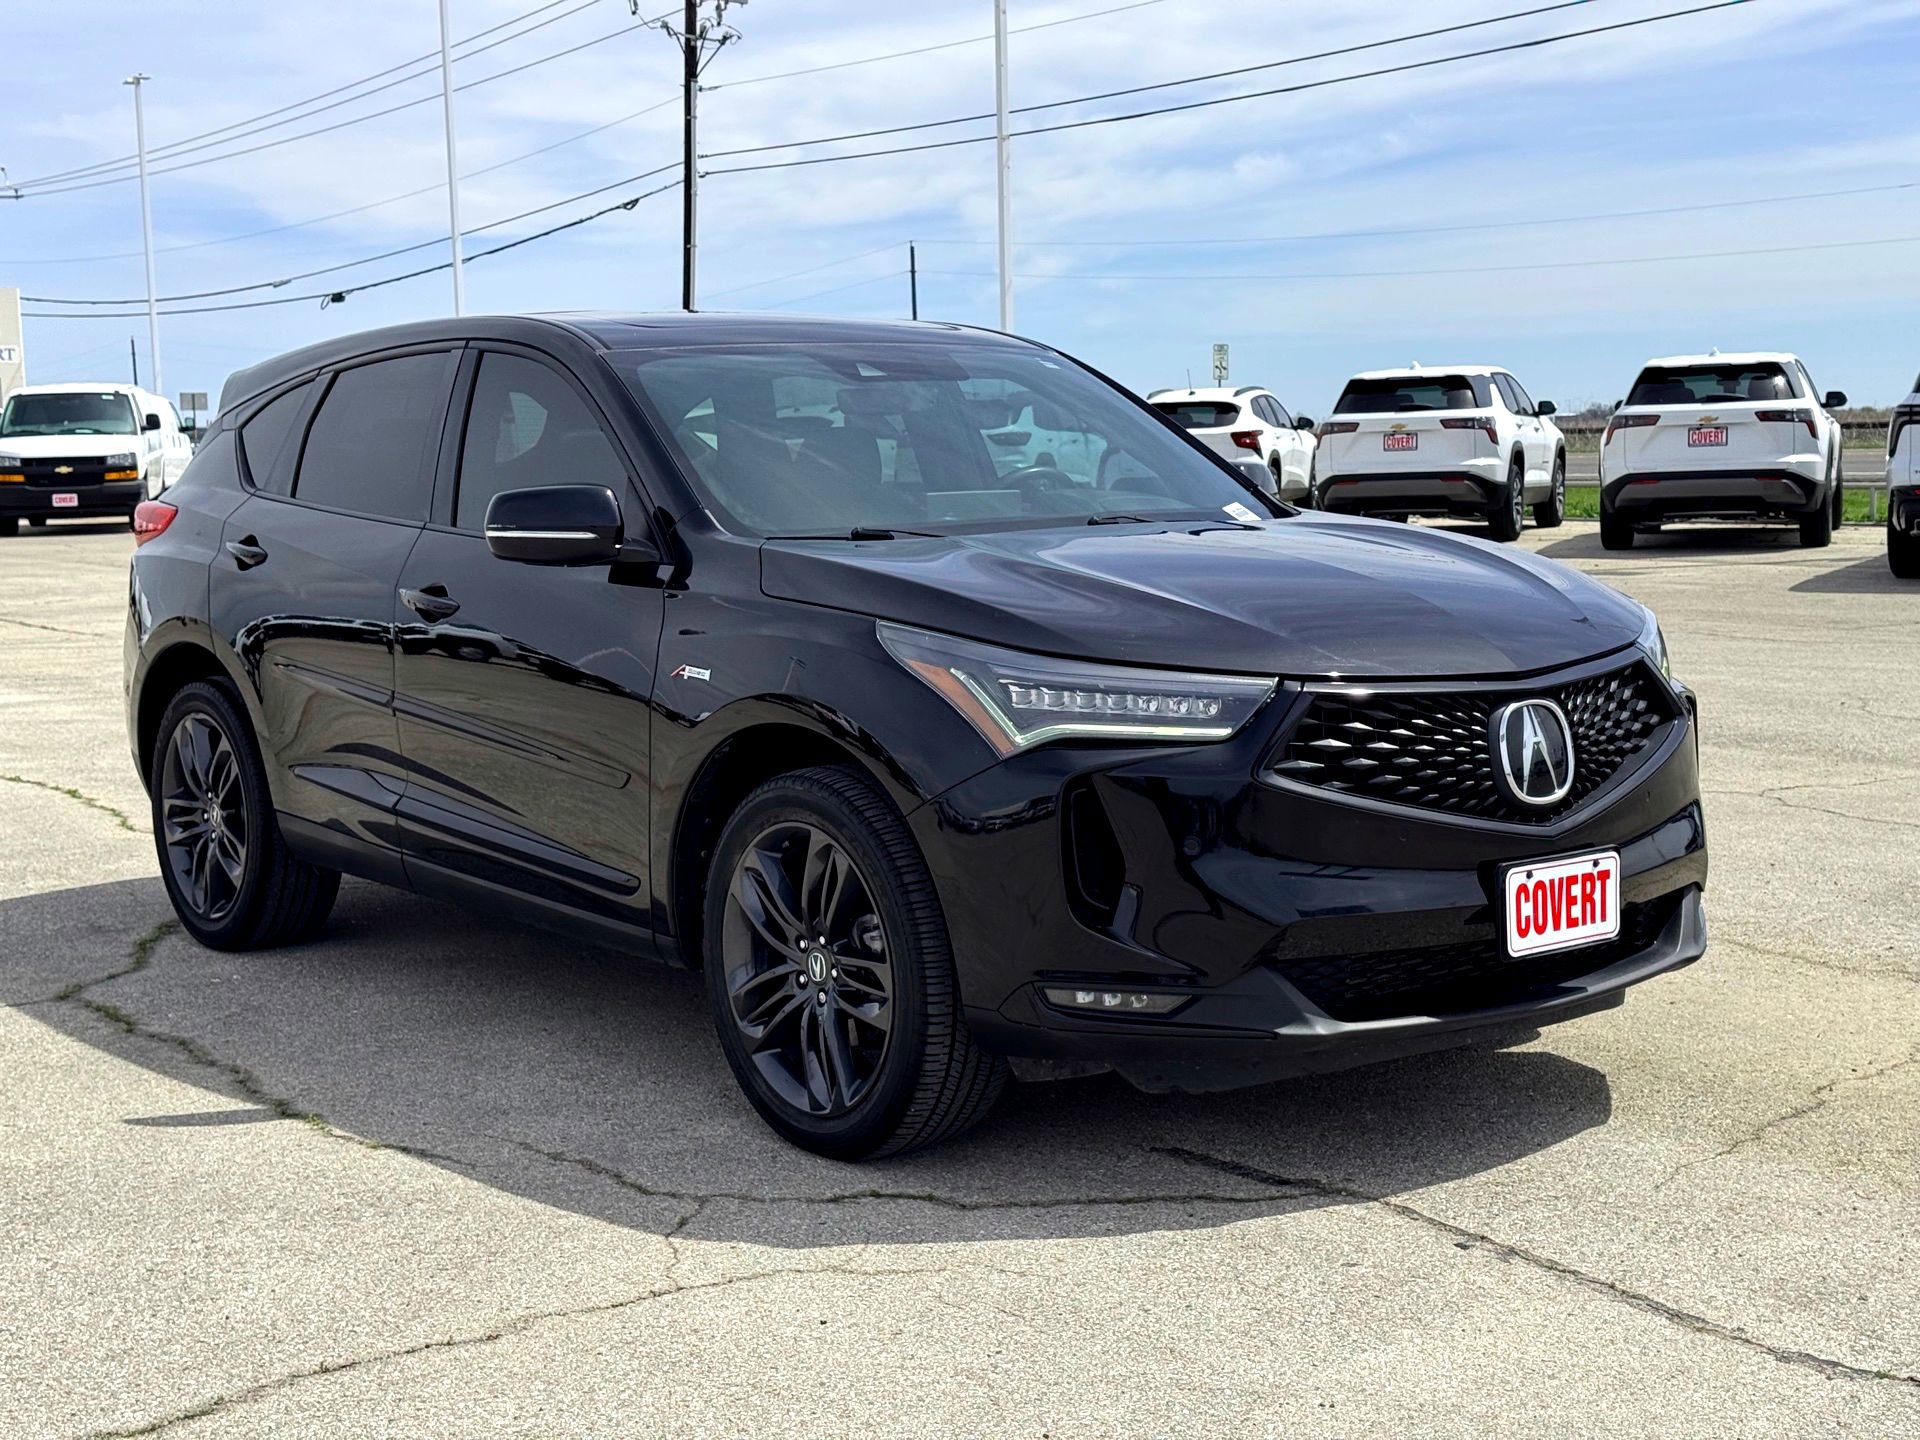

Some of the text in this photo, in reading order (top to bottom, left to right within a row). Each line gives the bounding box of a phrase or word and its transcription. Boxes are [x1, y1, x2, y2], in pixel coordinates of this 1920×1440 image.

[1386, 435, 1414, 448] COVERT
[1691, 430, 1724, 444] COVERT
[1515, 869, 1610, 938] COVERT
